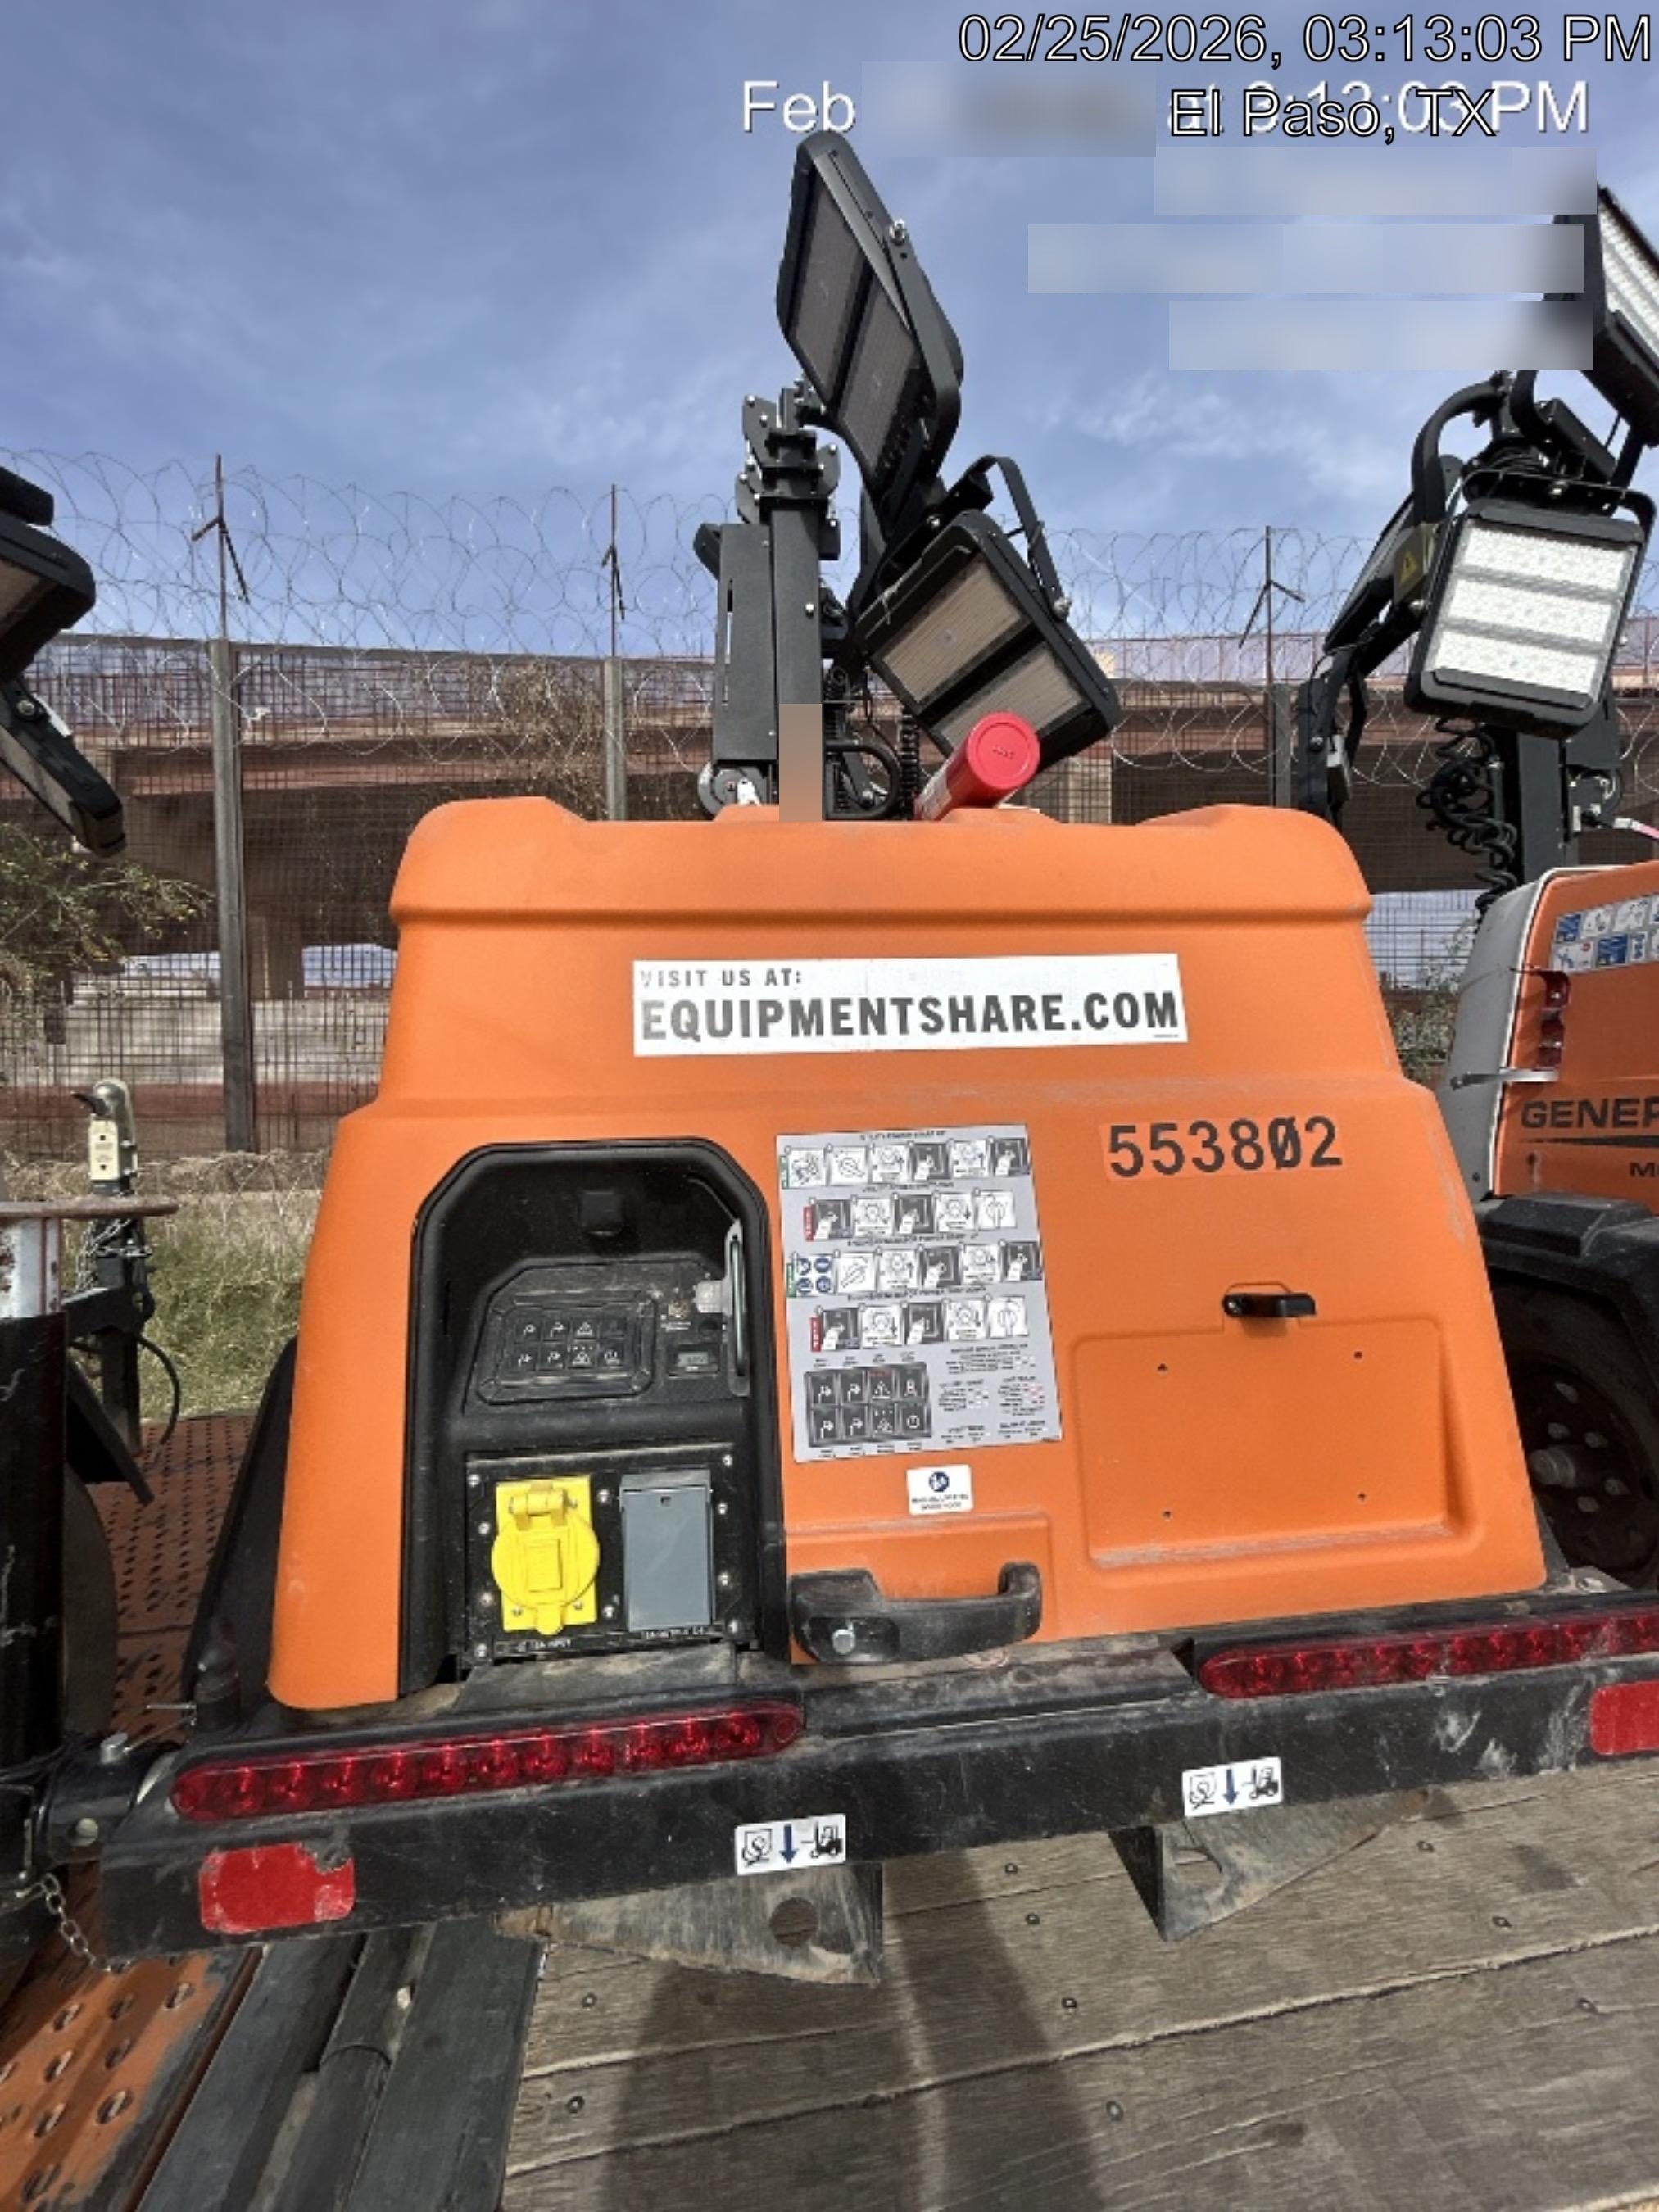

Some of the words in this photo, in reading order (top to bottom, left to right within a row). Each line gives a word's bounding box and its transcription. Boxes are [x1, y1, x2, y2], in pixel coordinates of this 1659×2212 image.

[641, 969, 708, 987] VISIT
[722, 969, 750, 986] US
[765, 968, 802, 987] AT:
[641, 990, 1179, 1042] EQUIPMENTSHARE.COM
[1108, 1115, 1343, 1177] 553802
